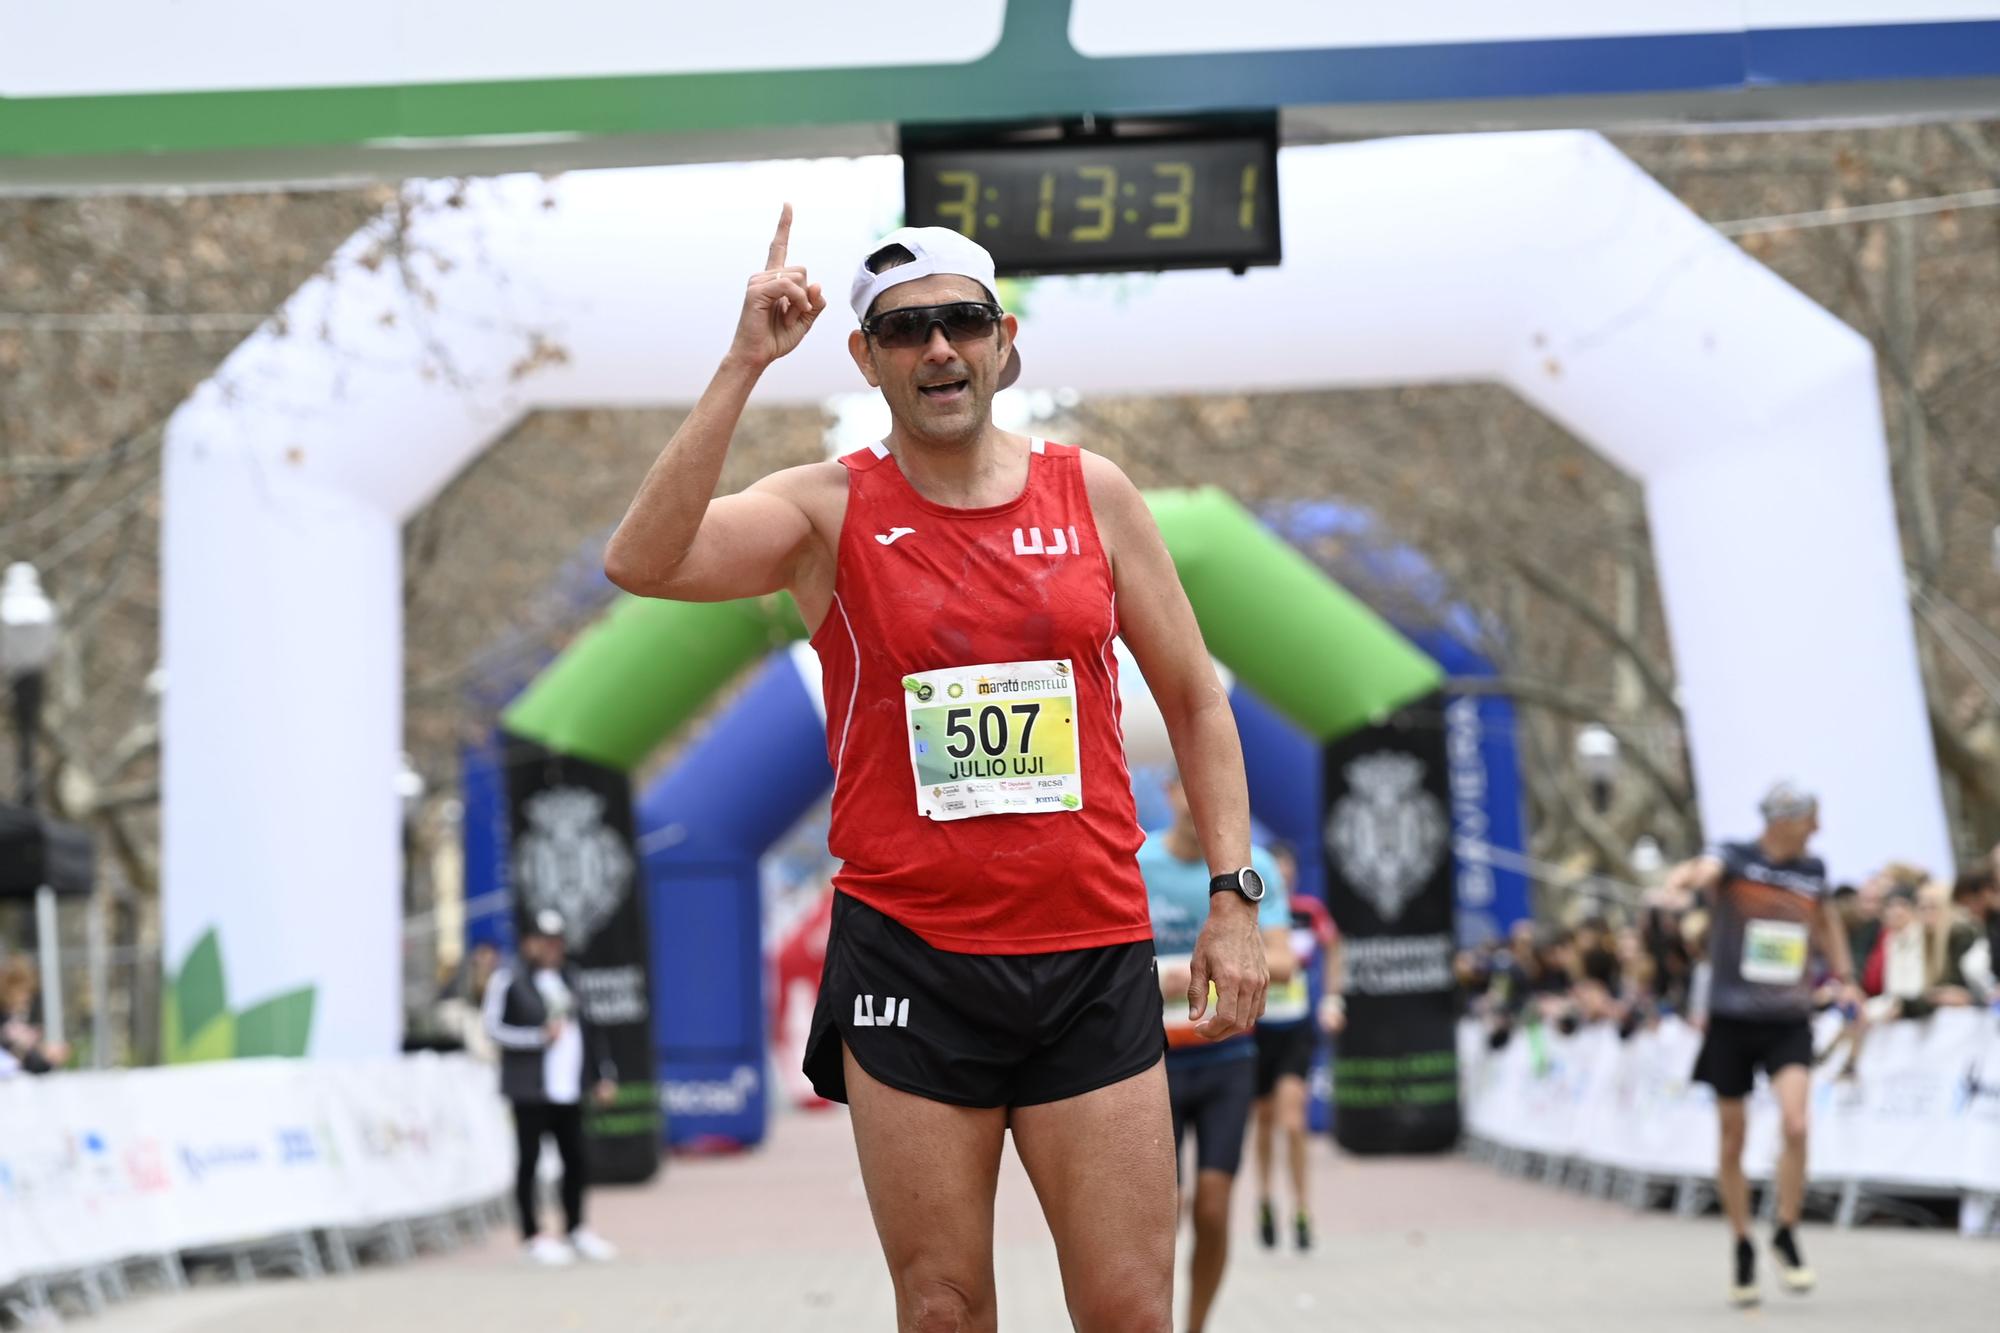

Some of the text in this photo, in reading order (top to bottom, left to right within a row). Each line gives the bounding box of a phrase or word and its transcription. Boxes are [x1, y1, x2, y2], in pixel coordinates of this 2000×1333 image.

[1012, 526, 1080, 556] UJI
[946, 703, 1041, 759] 507
[949, 757, 1044, 780] JULIO UJI
[853, 994, 910, 1027] UJI
